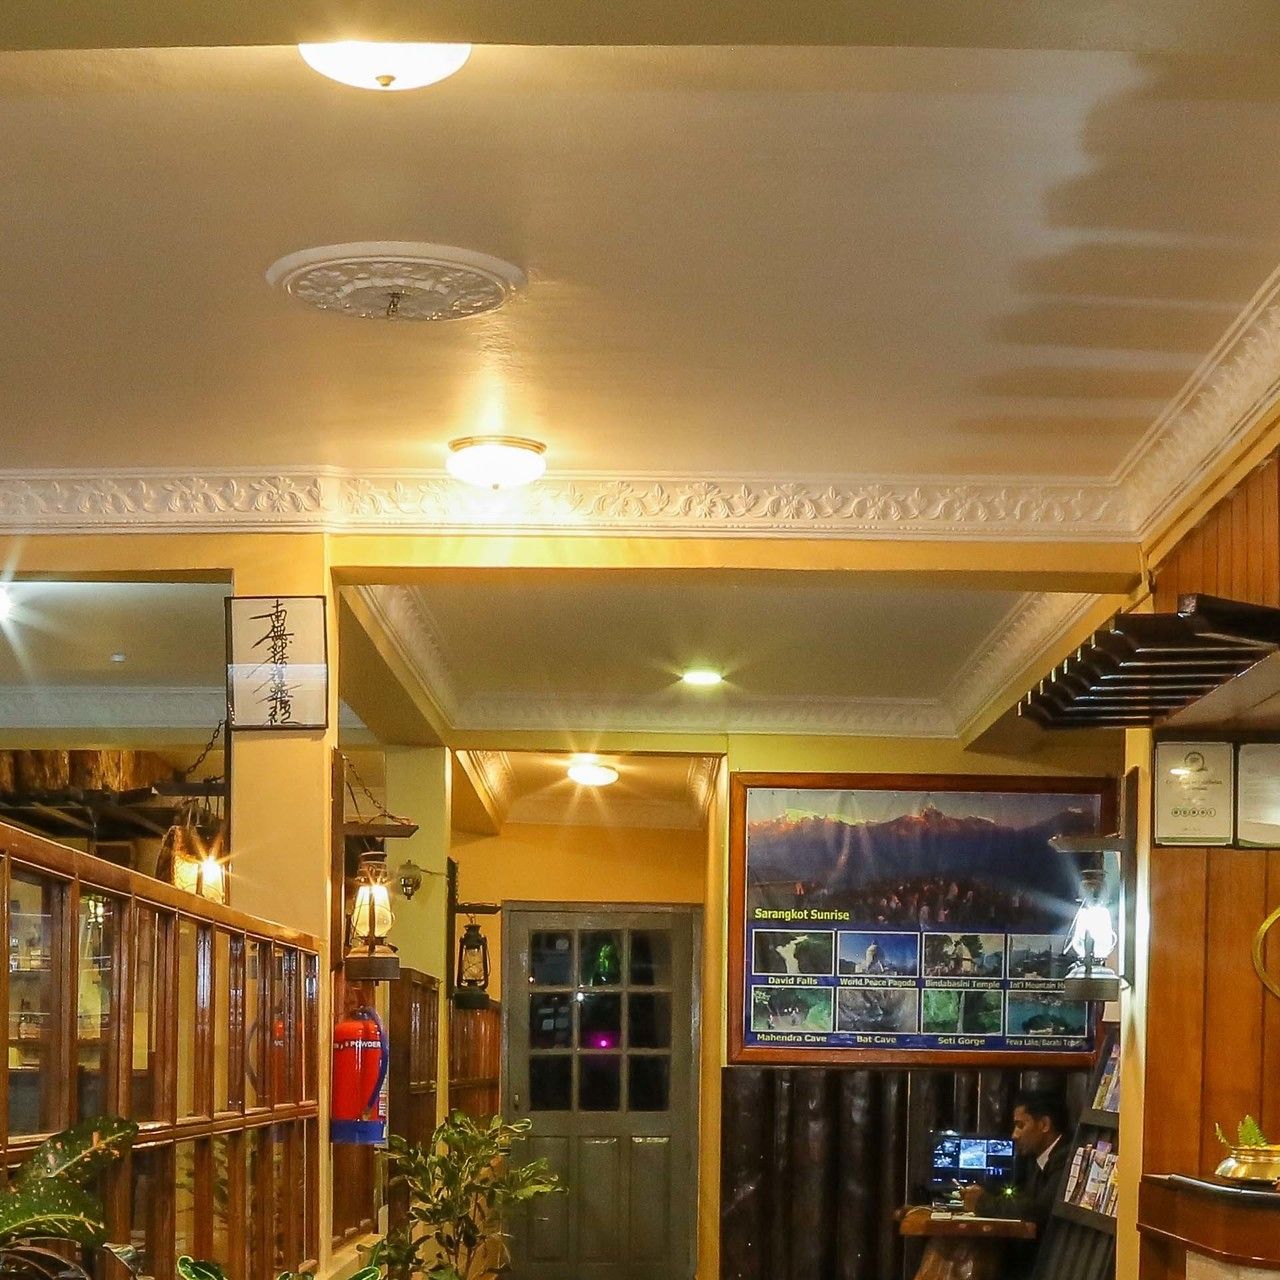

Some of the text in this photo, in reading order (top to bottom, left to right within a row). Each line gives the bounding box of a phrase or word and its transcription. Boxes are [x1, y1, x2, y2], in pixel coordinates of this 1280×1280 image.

[754, 908, 850, 922] Sarangkot Sunrise
[768, 976, 818, 985] David Falls
[840, 978, 863, 986] World
[864, 978, 887, 987] Peace
[972, 981, 1000, 989] Temple
[757, 1033, 827, 1043] Mahendra Cave
[857, 1035, 897, 1044] Bat Cave
[938, 1037, 986, 1046] Seti Gorge
